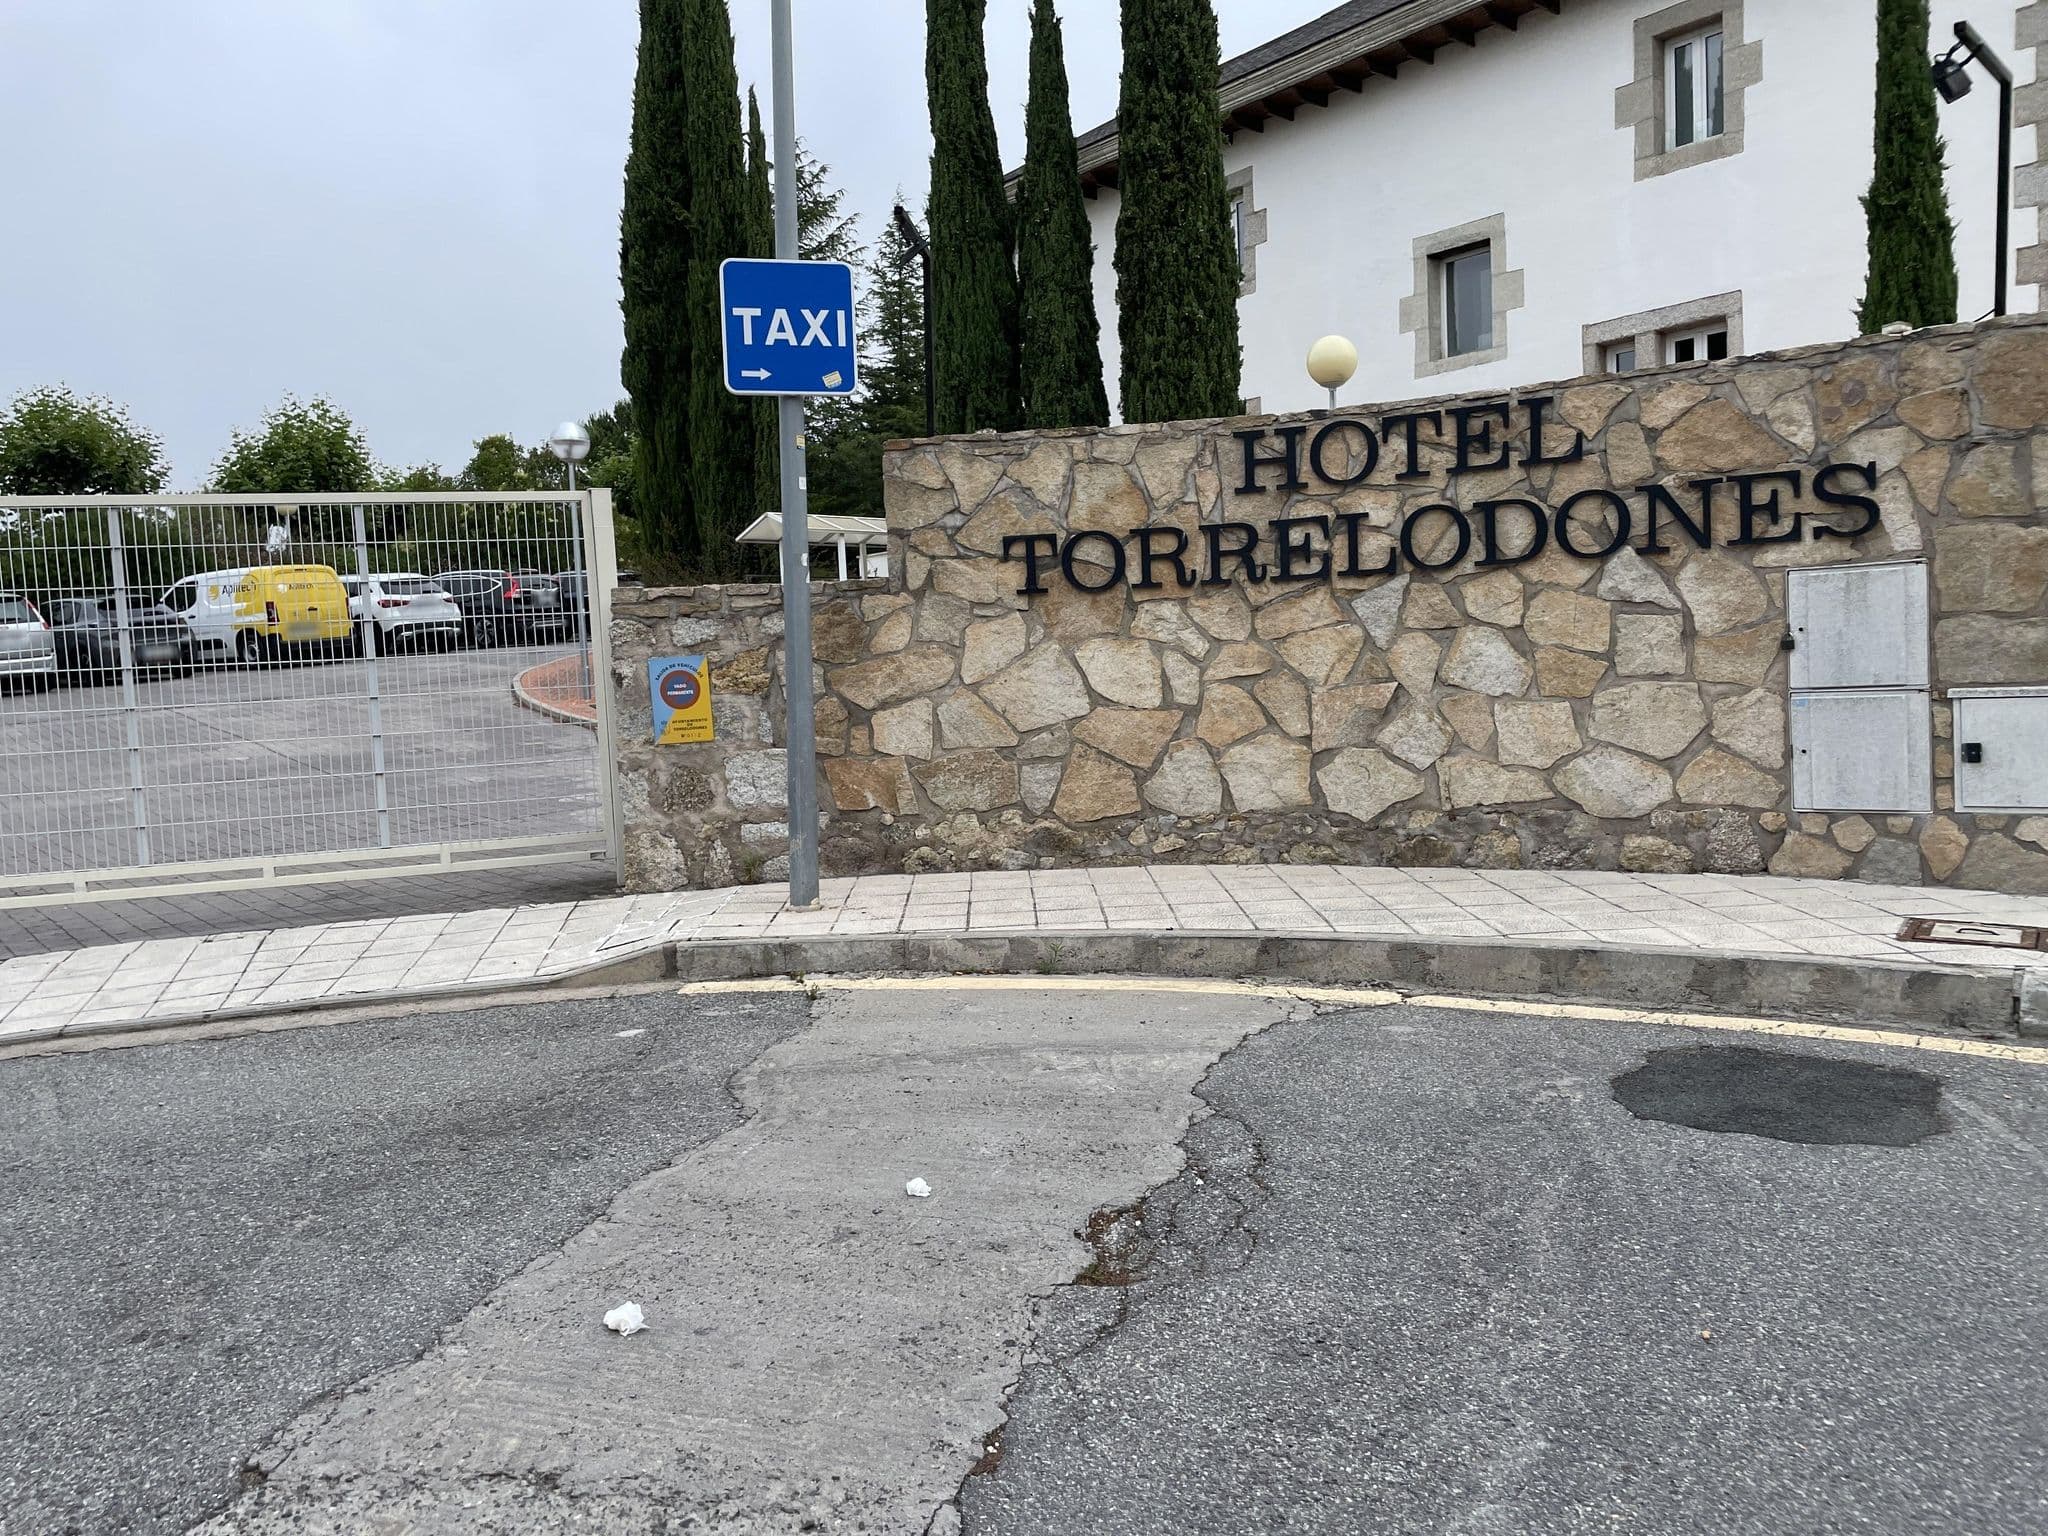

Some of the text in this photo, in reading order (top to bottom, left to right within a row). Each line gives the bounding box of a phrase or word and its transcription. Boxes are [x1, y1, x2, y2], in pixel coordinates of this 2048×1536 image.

[732, 307, 847, 348] TAXI
[1233, 397, 1583, 495] HOTEL
[1003, 461, 1881, 594] TORRELODONES
